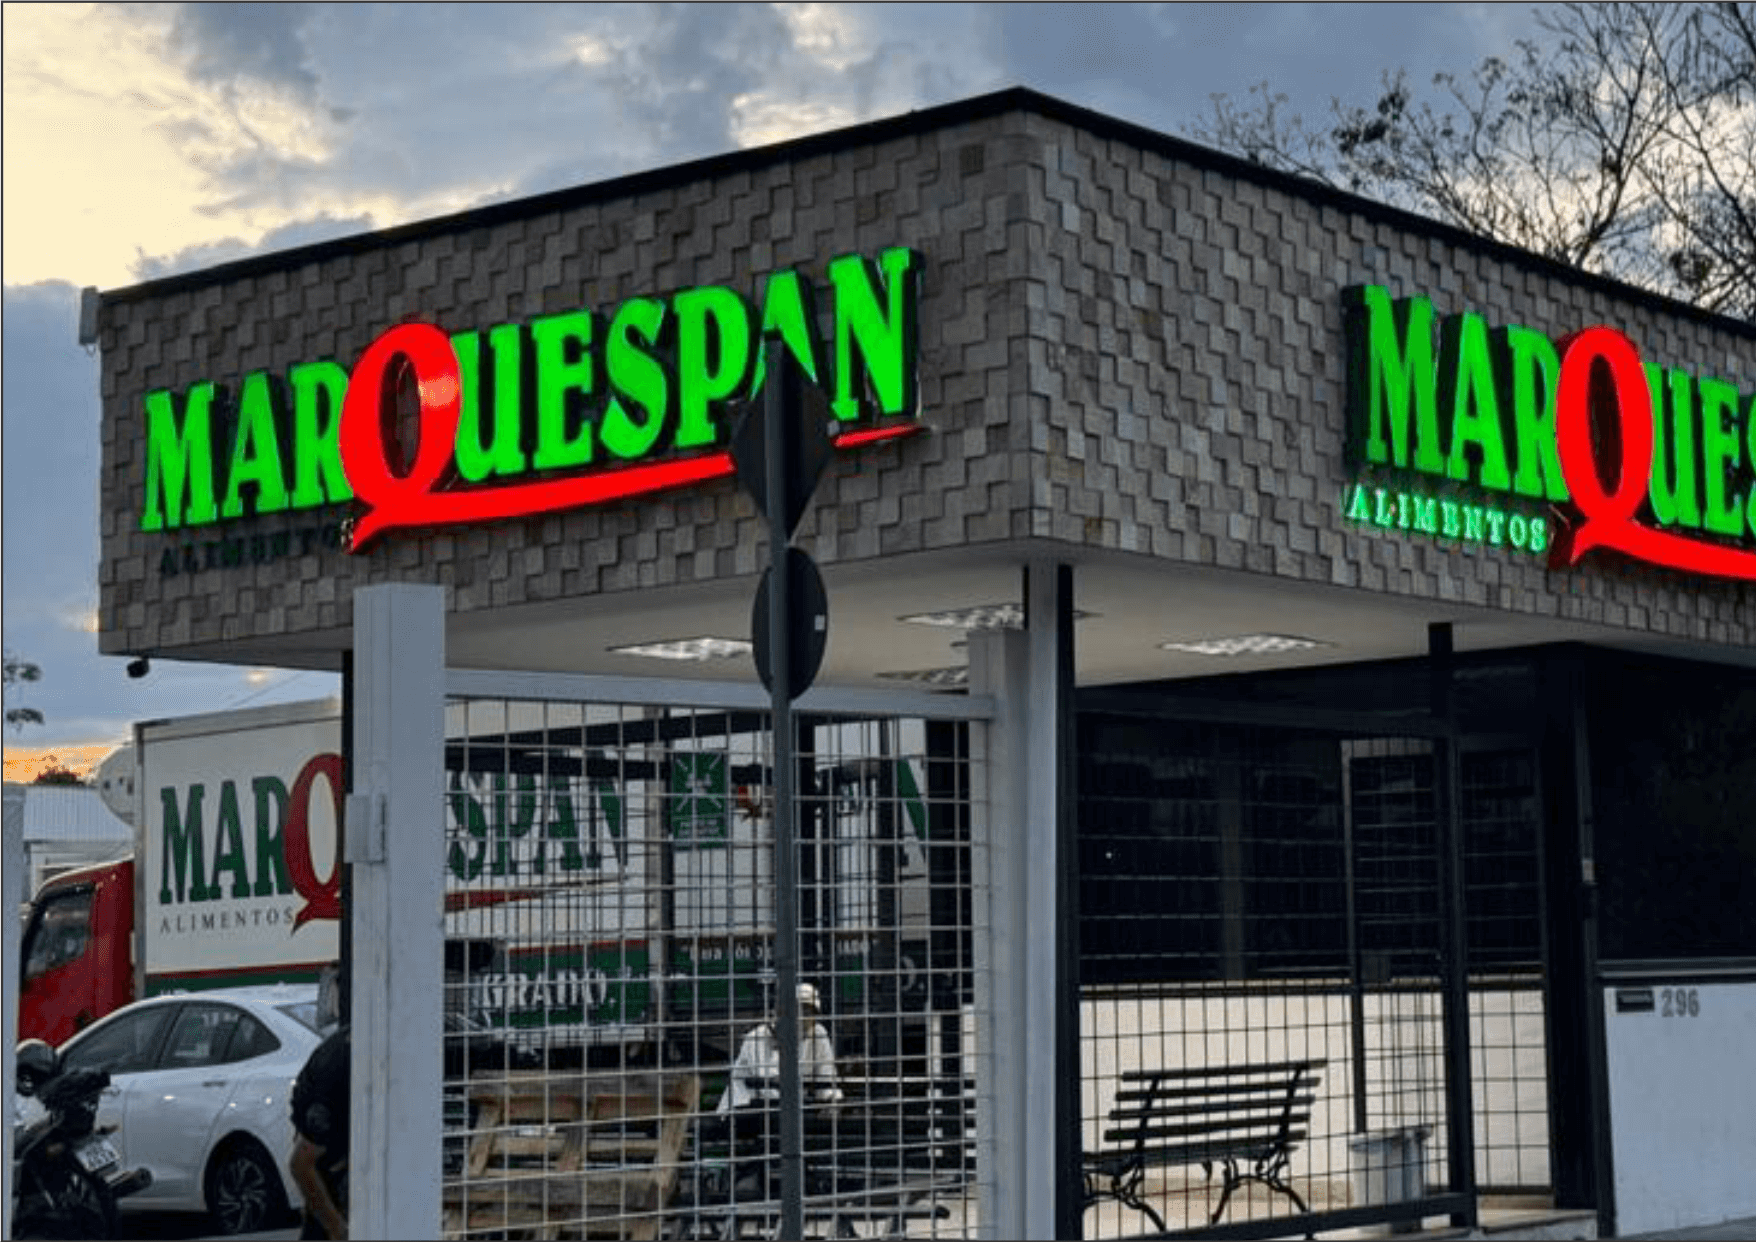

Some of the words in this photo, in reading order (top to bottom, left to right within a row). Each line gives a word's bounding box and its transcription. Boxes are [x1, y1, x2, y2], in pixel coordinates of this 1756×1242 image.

[1347, 484, 1547, 552] ALIMENTOS
[160, 906, 296, 934] ALIMENTOS
[1661, 988, 1699, 1017] 296
